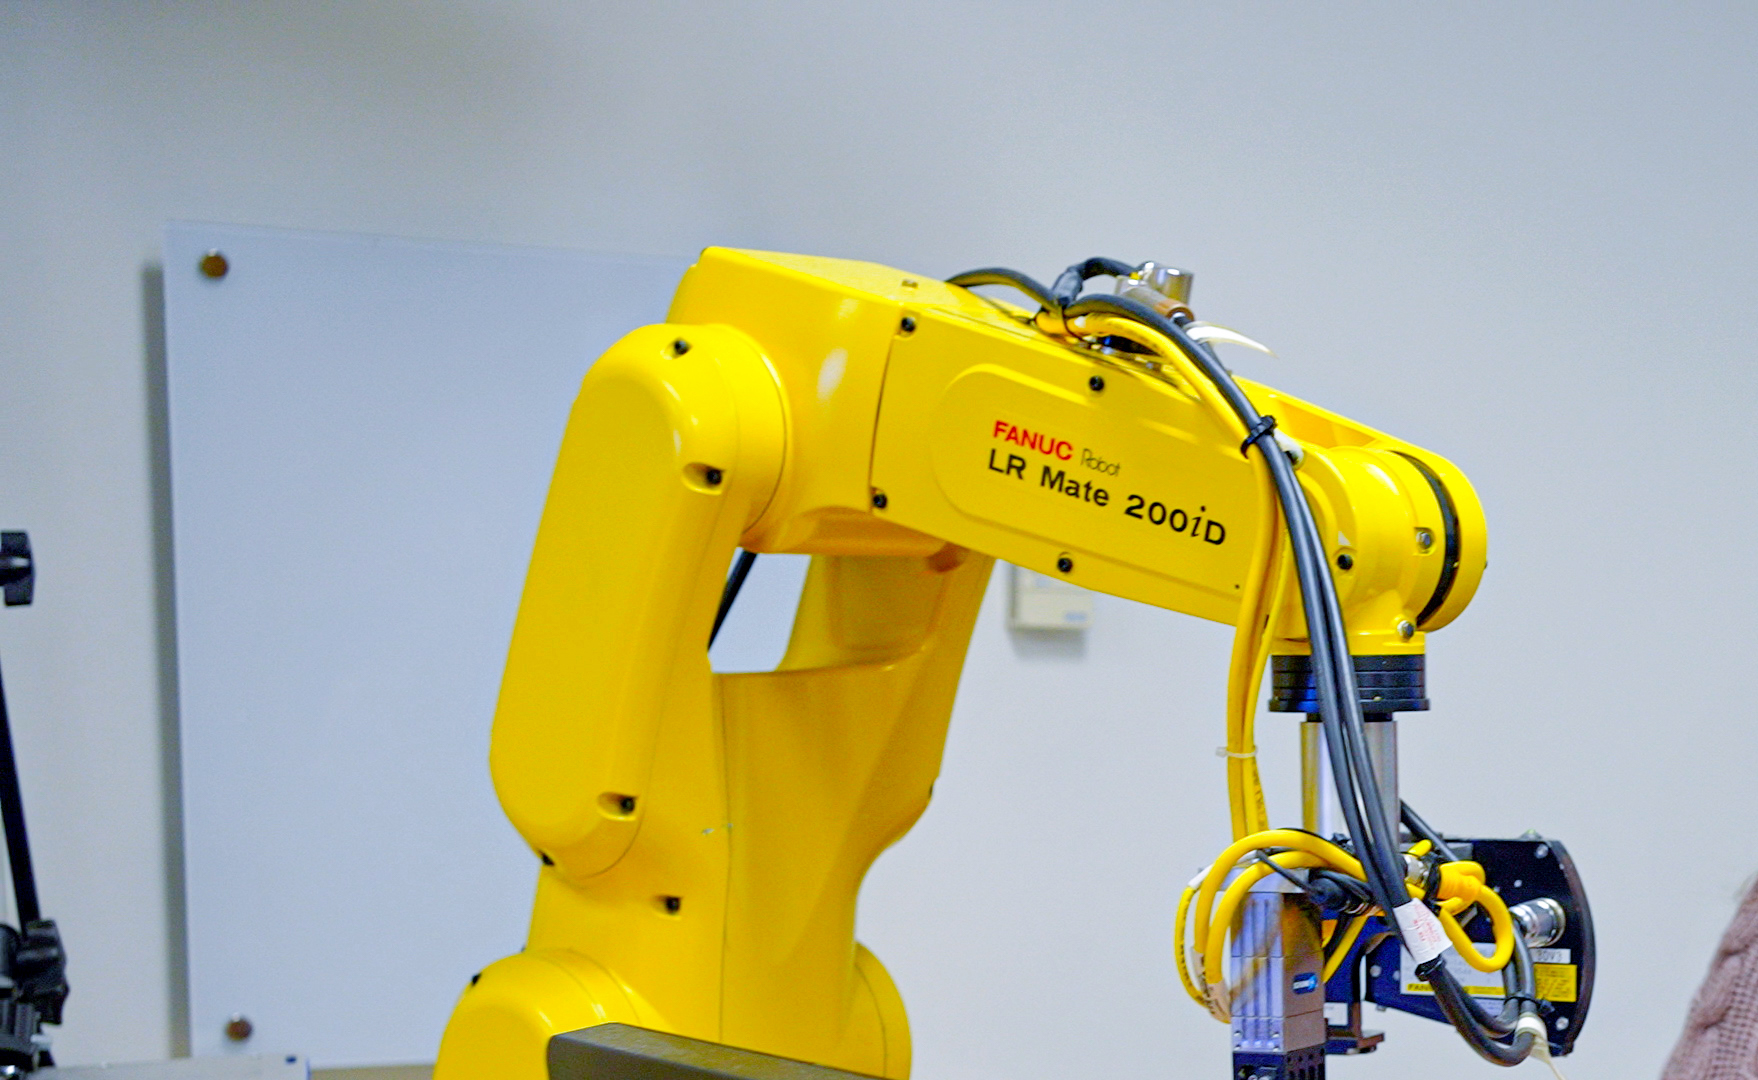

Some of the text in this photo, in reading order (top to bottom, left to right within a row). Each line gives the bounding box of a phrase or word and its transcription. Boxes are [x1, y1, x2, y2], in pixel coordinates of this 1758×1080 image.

[993, 420, 1121, 477] FANUC Robot
[988, 448, 1226, 546] LR Mate 200iD
